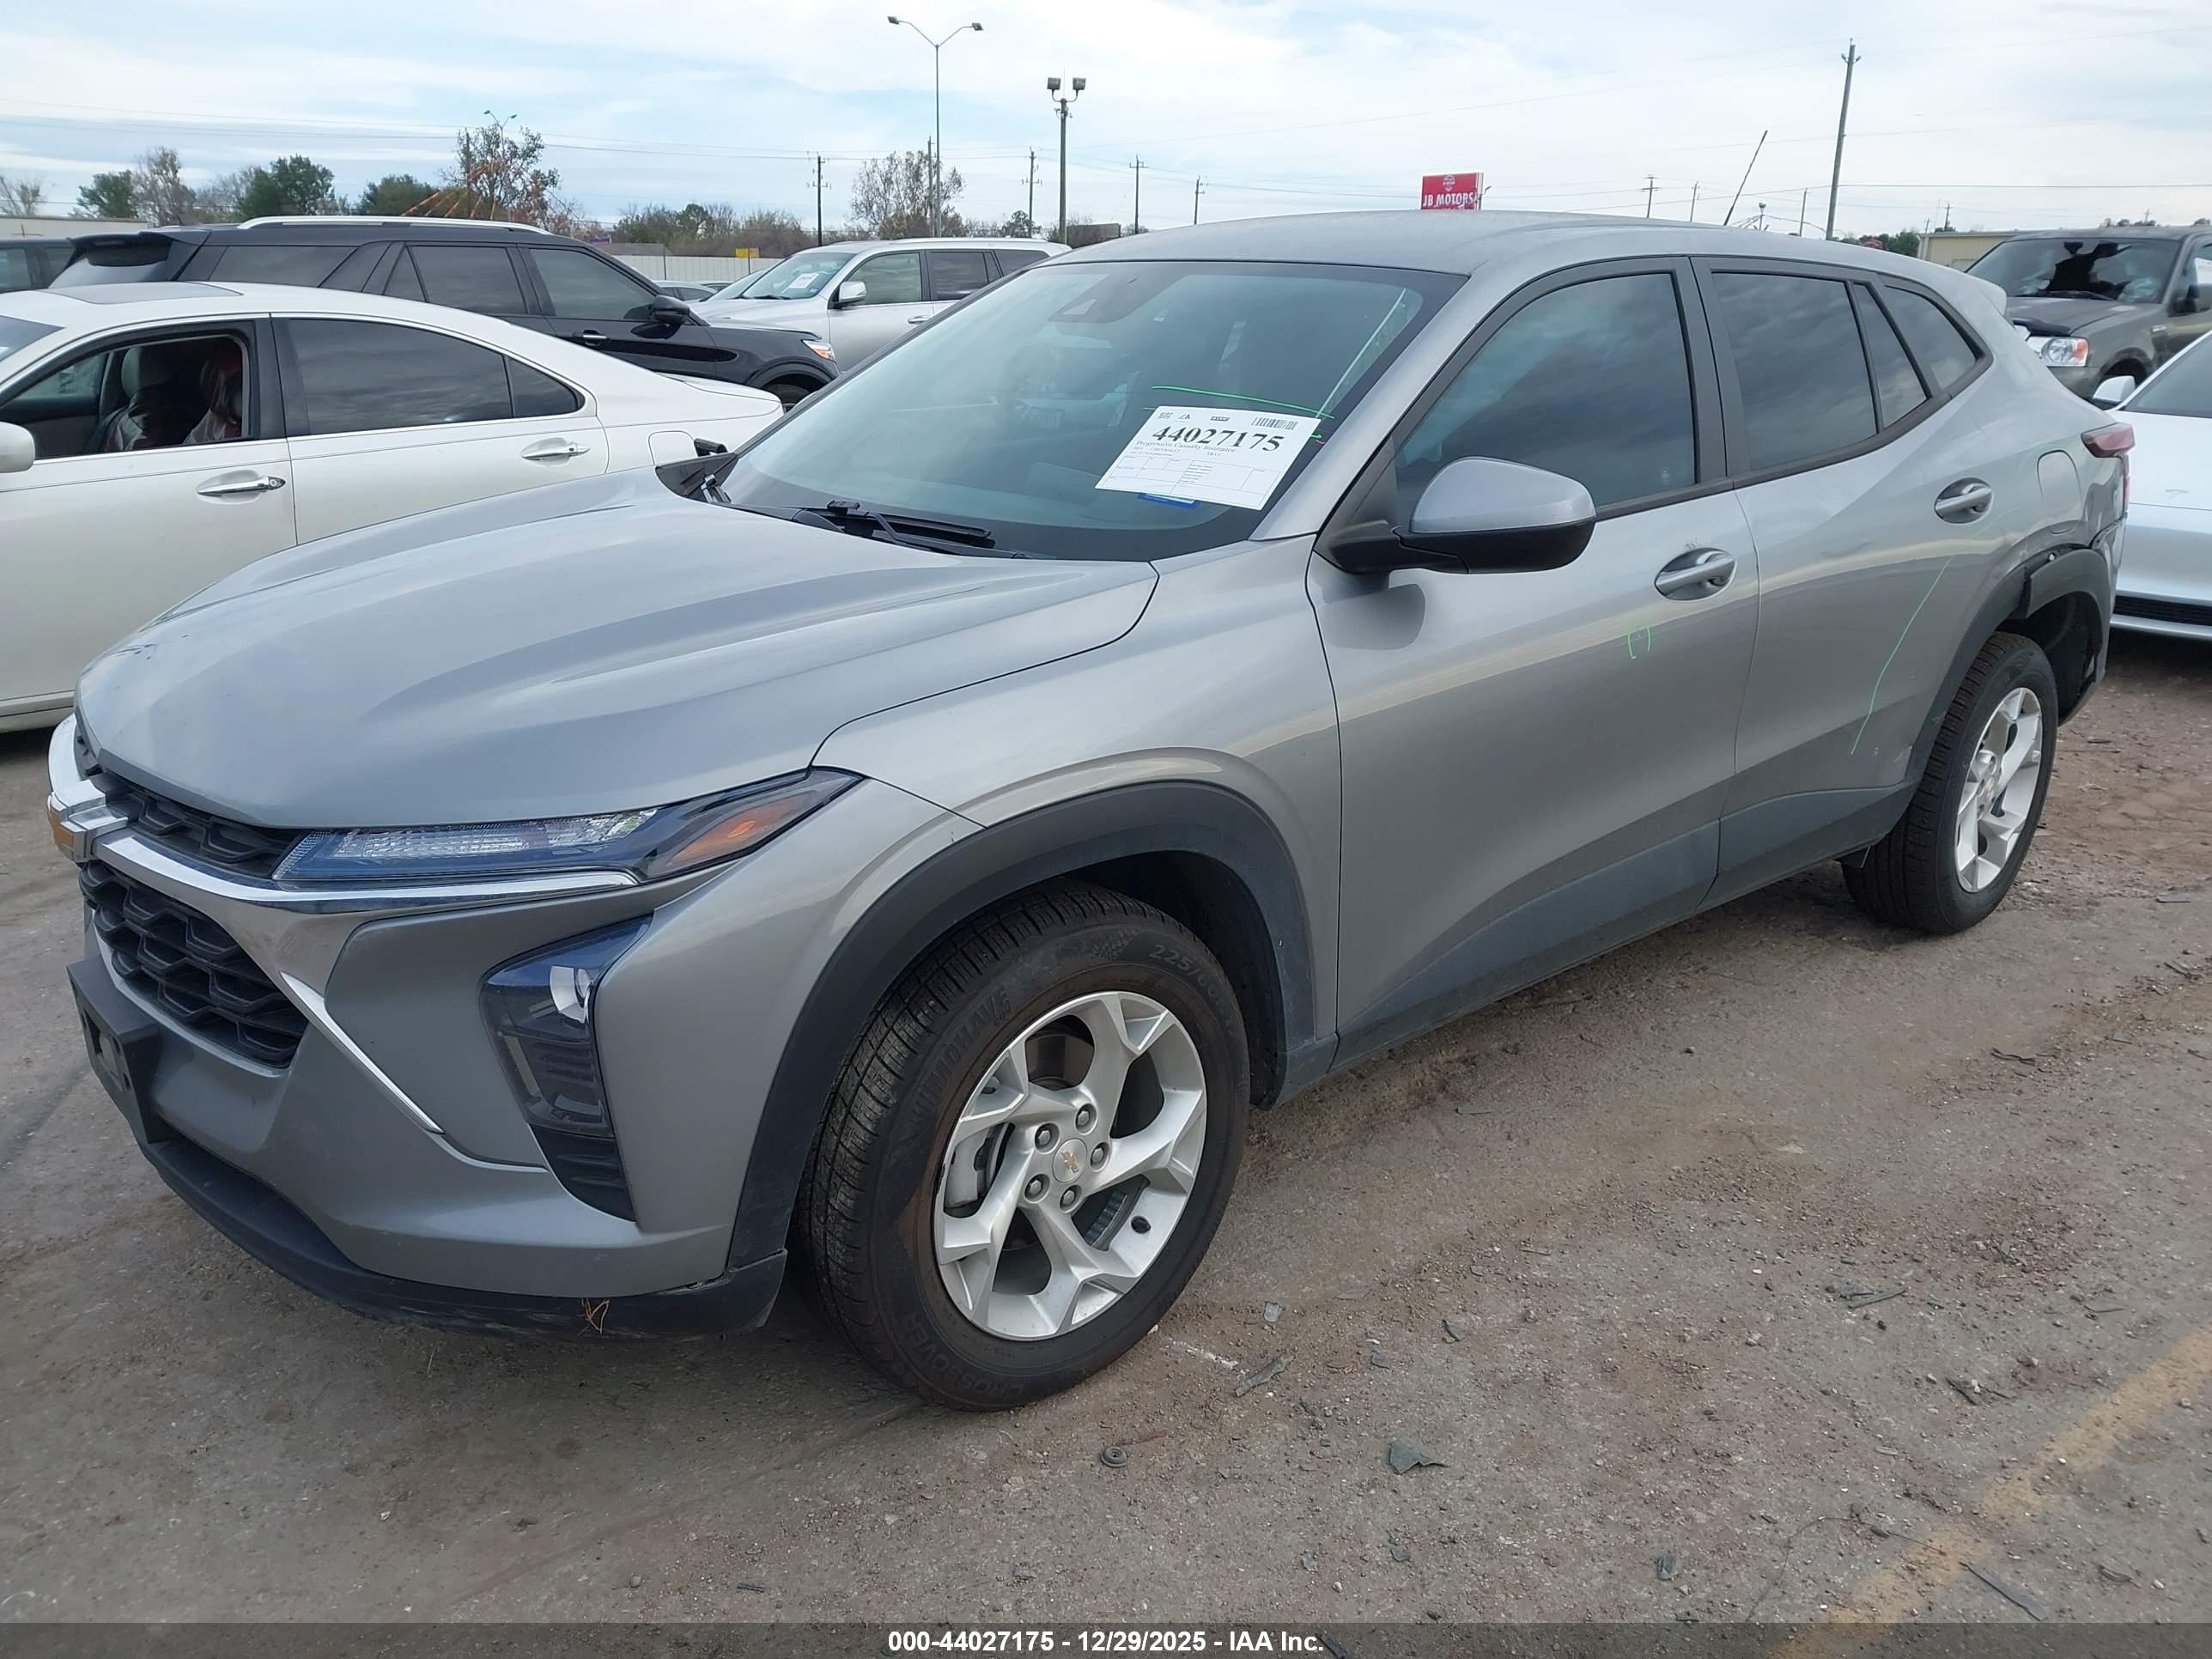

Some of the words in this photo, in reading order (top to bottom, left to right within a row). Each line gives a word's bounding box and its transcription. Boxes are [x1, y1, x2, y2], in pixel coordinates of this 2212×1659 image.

[1423, 194, 1434, 207] JB
[1437, 192, 1474, 207] MOTORS
[1152, 425, 1285, 453] 44027175
[1202, 445, 1237, 453] Insurance
